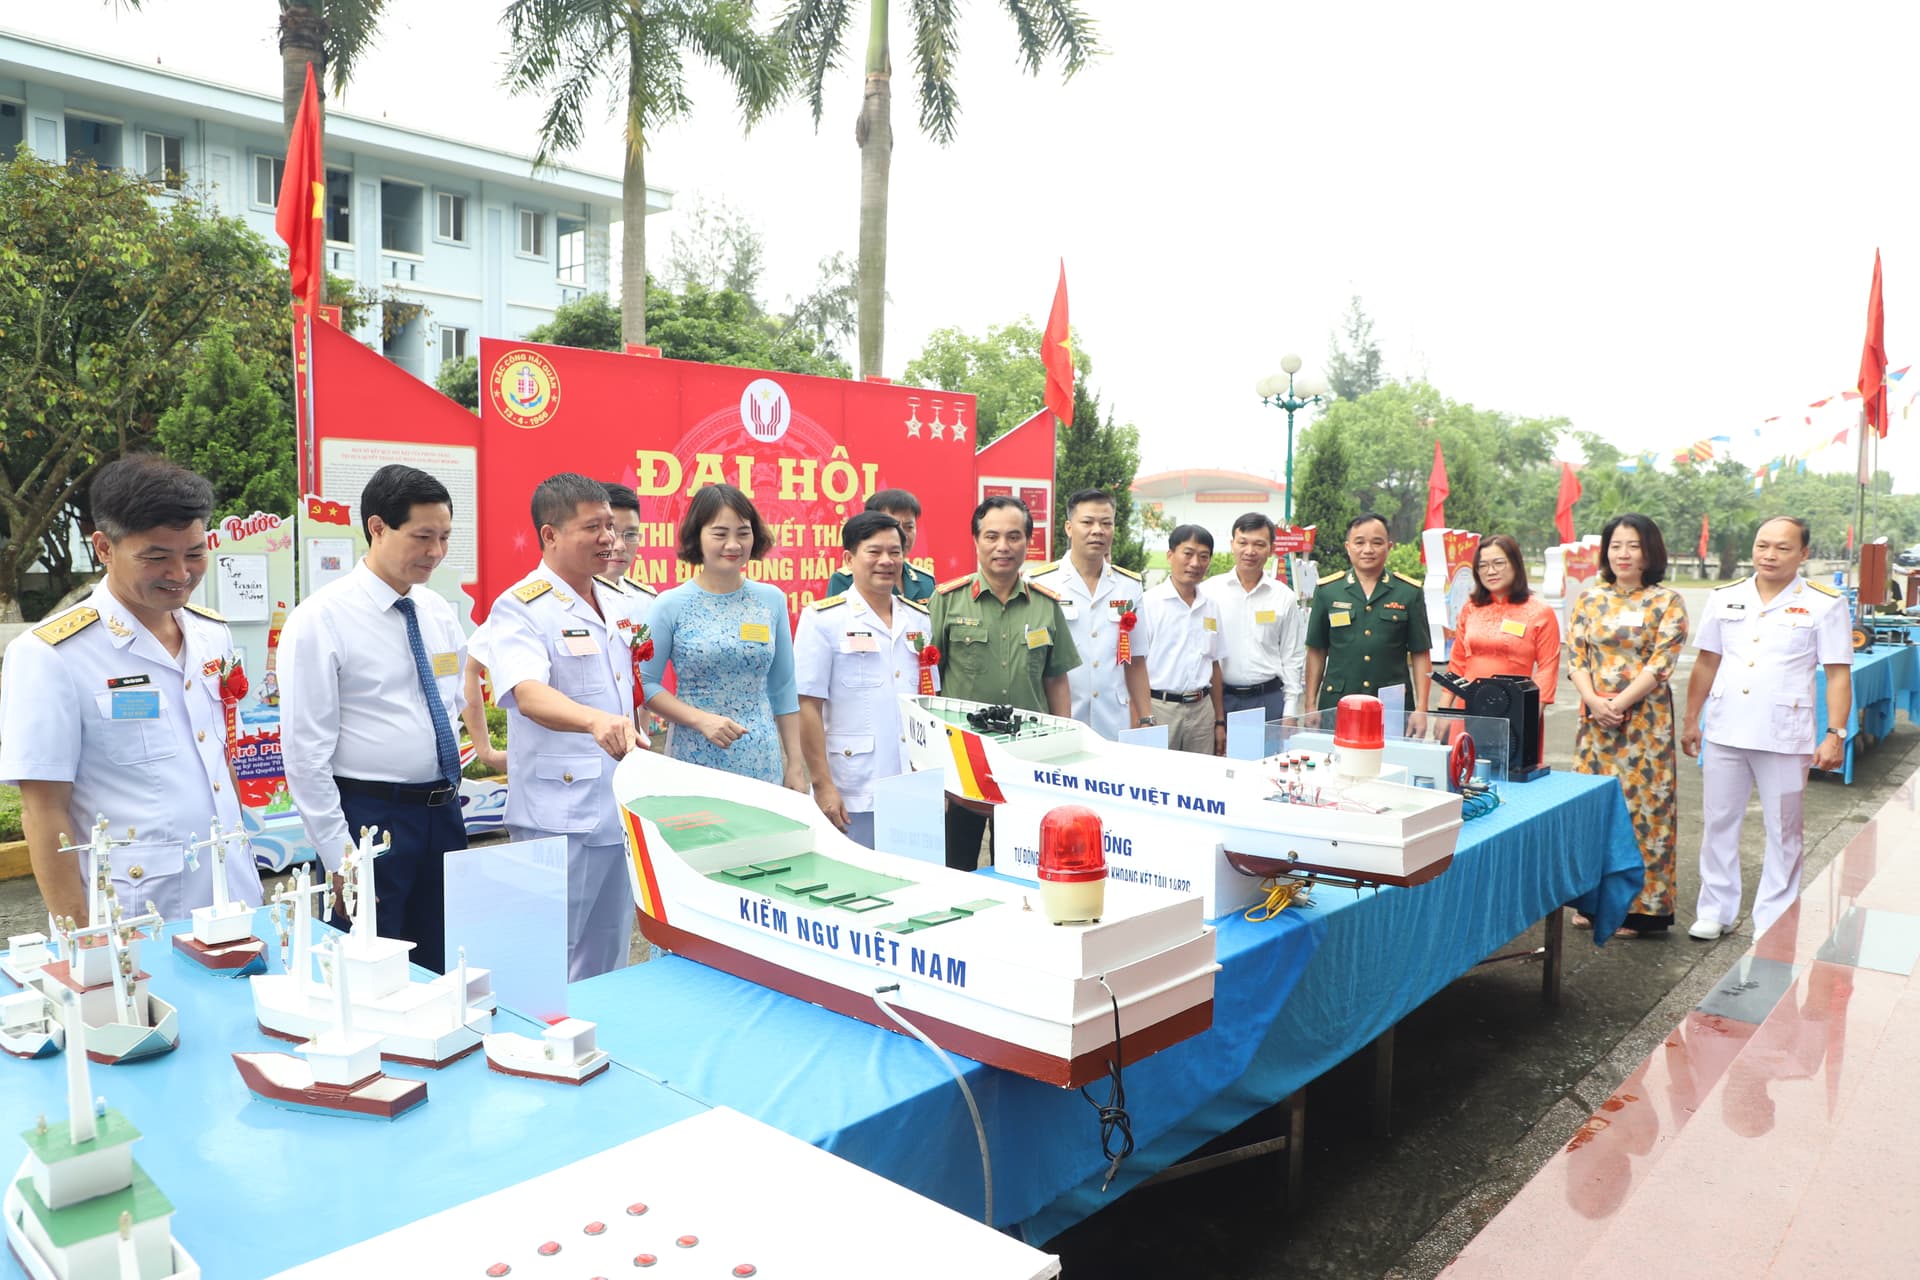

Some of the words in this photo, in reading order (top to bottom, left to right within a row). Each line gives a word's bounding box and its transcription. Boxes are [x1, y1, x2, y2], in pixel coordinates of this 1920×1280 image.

[778, 445, 879, 514] HỘI
[1033, 768, 1079, 789] KIỂM
[1084, 778, 1125, 797] NGƯ
[1129, 786, 1170, 806] VIỆT
[1177, 794, 1226, 816] NAM
[739, 897, 788, 934] KIỂM
[796, 916, 839, 950] NGƯ
[850, 930, 899, 966] VIỆT
[911, 947, 966, 988] NAM
